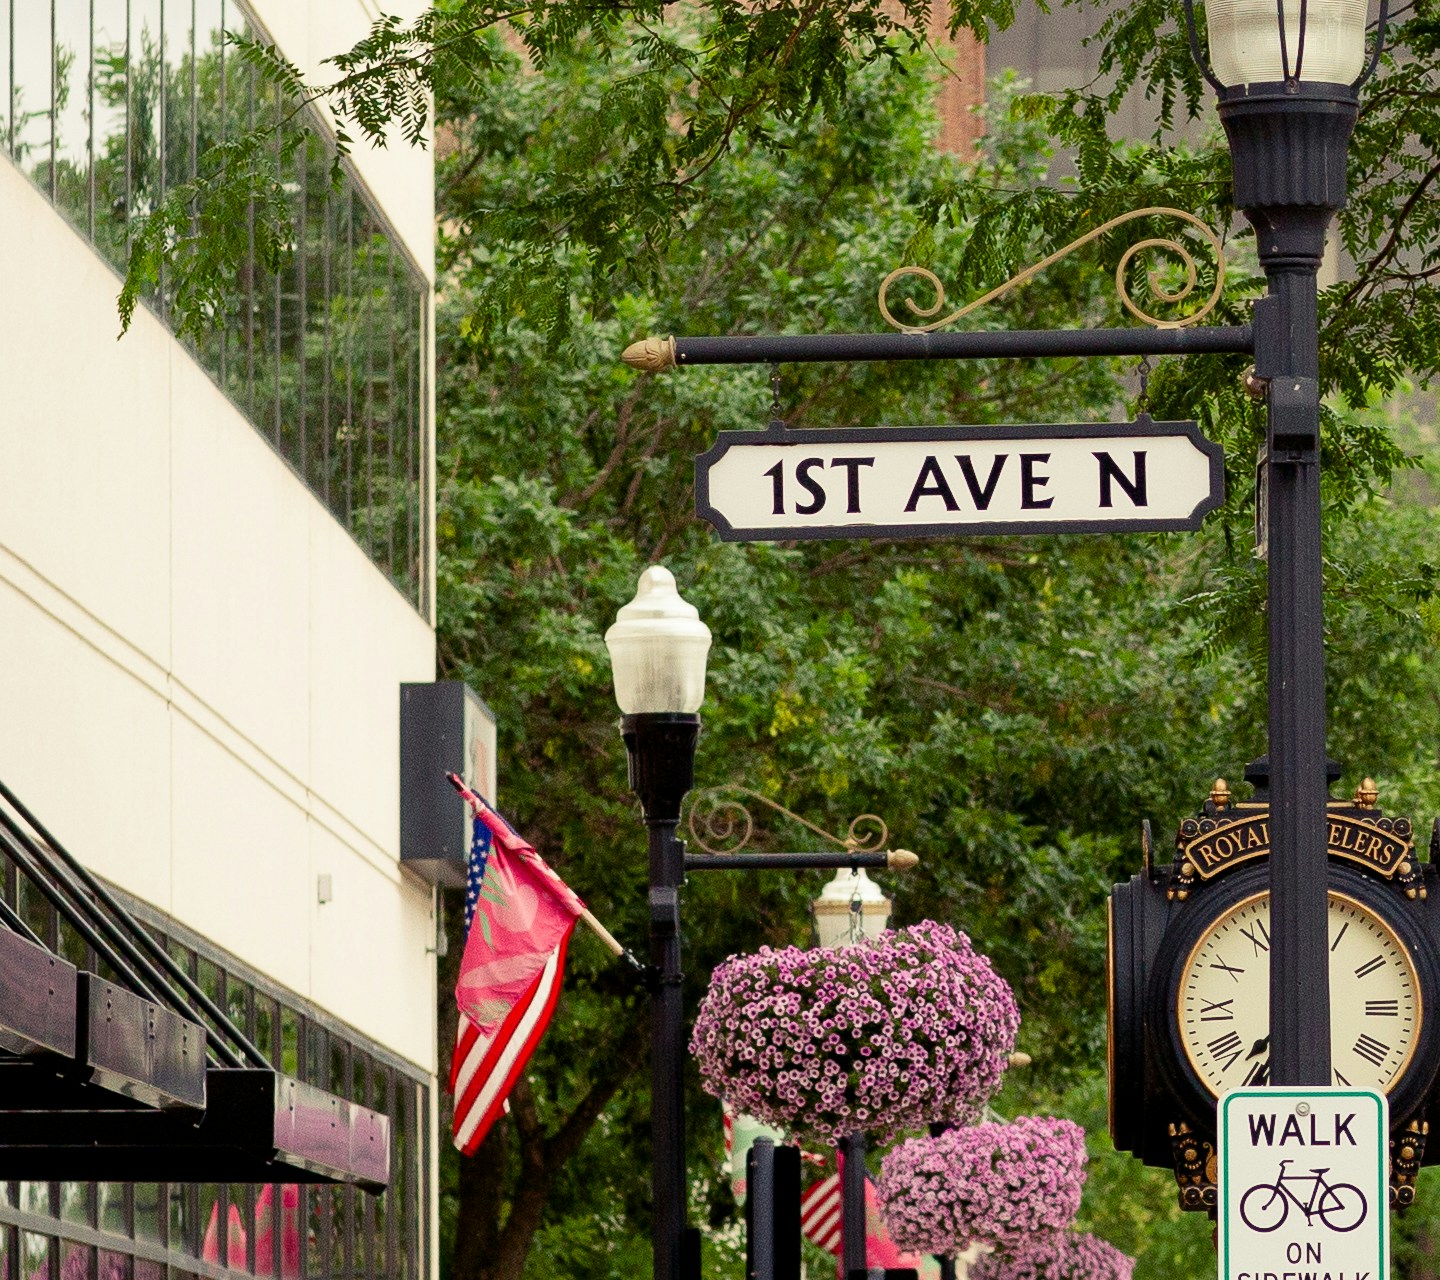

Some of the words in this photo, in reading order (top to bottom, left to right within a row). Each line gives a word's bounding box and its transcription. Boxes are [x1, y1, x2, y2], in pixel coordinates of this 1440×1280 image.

[763, 456, 876, 515] 1ST
[904, 453, 1055, 512] AVE
[1091, 451, 1148, 508] N
[1326, 823, 1395, 865] ELERS
[1248, 1114, 1357, 1146] WALK
[1286, 1242, 1322, 1264] ON
